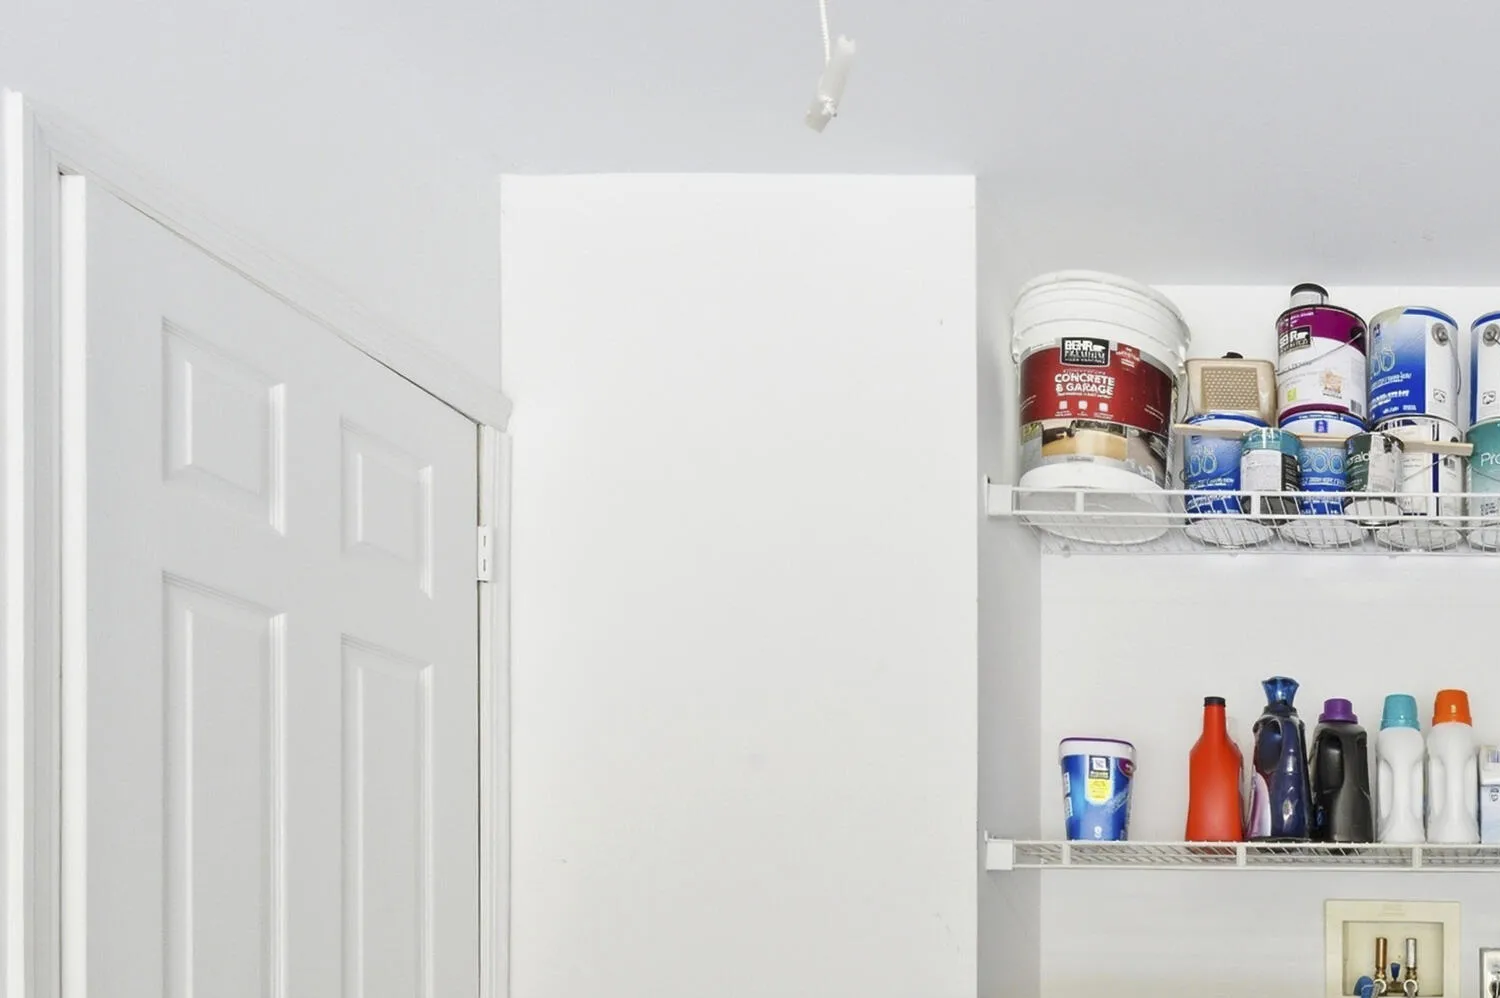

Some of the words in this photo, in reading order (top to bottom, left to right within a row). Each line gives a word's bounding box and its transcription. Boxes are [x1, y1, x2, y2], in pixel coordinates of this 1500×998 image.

[1064, 340, 1093, 352] BEHR
[1054, 372, 1116, 387] CONCRETE
[1066, 382, 1114, 396] GARAGE
